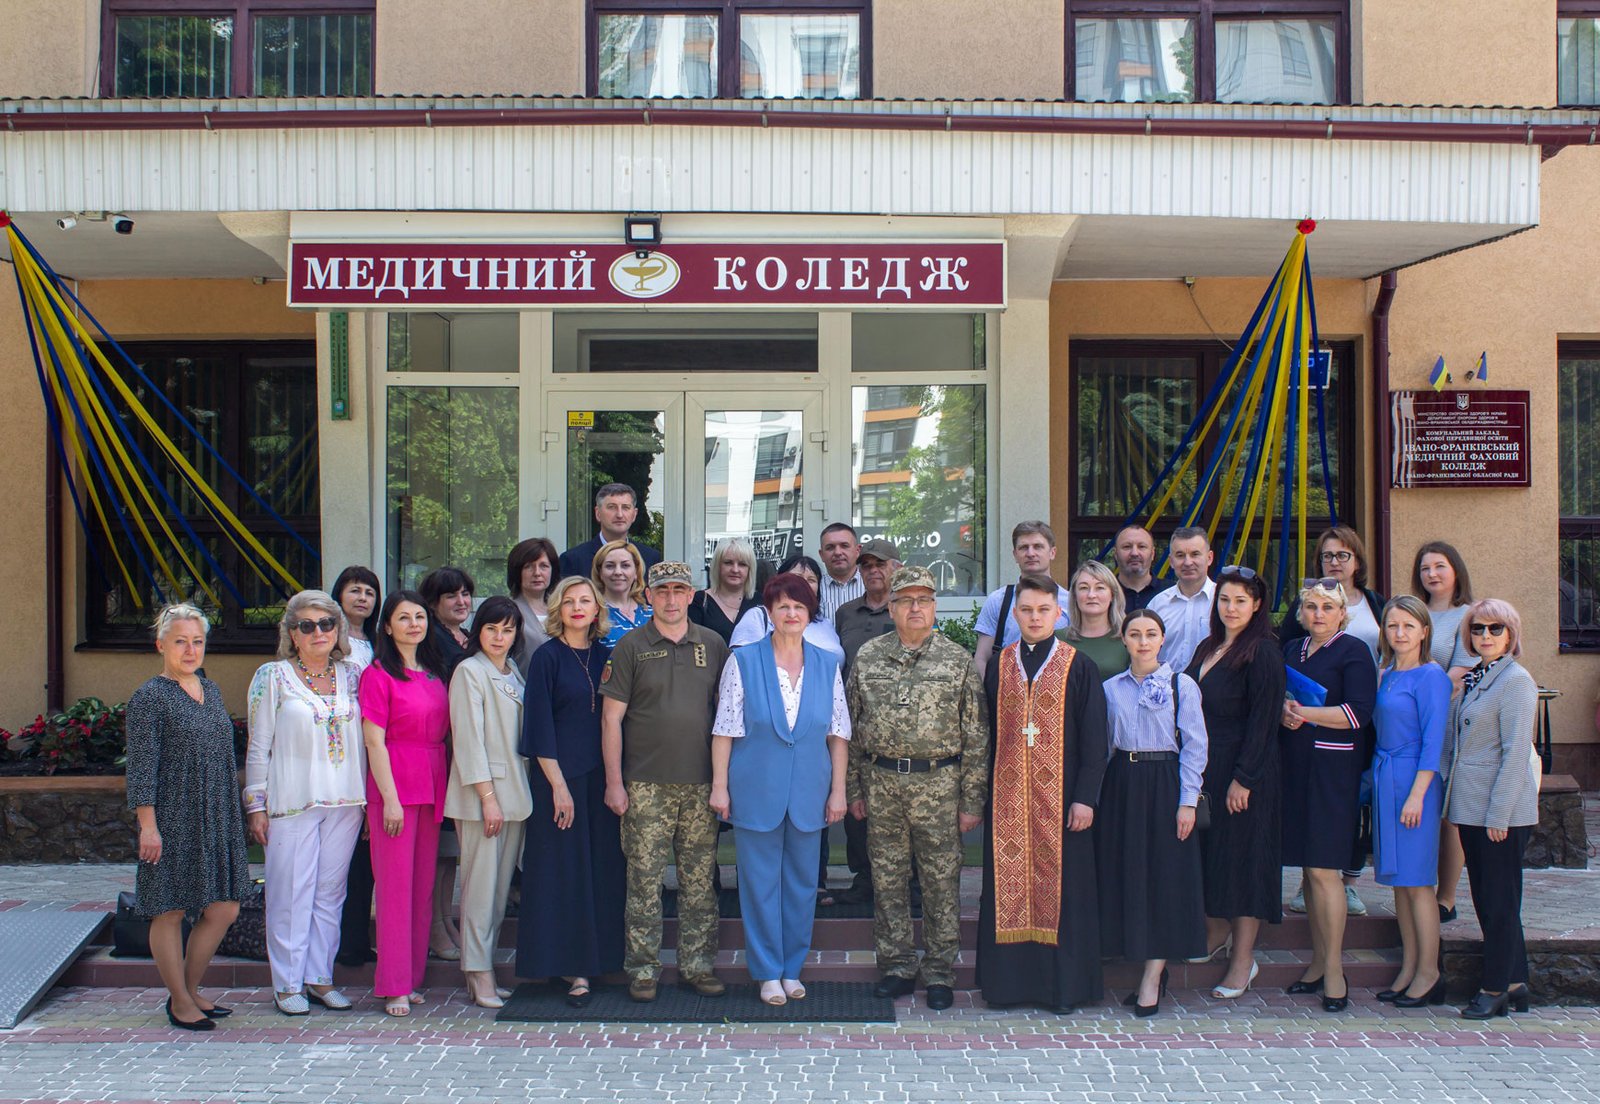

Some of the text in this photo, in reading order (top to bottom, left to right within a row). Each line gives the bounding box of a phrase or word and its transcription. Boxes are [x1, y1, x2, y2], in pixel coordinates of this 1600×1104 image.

[302, 250, 970, 299] МЕДИЧНИЙ КОЛЕДЖ
[1404, 443, 1519, 451] ІВАНО-ФРАНКІВСЬКИЙ
[1406, 452, 1519, 462] МЕДИЧНИЙ ФАХОВИЙ
[1441, 462, 1486, 471] КОЛЕДЖ
